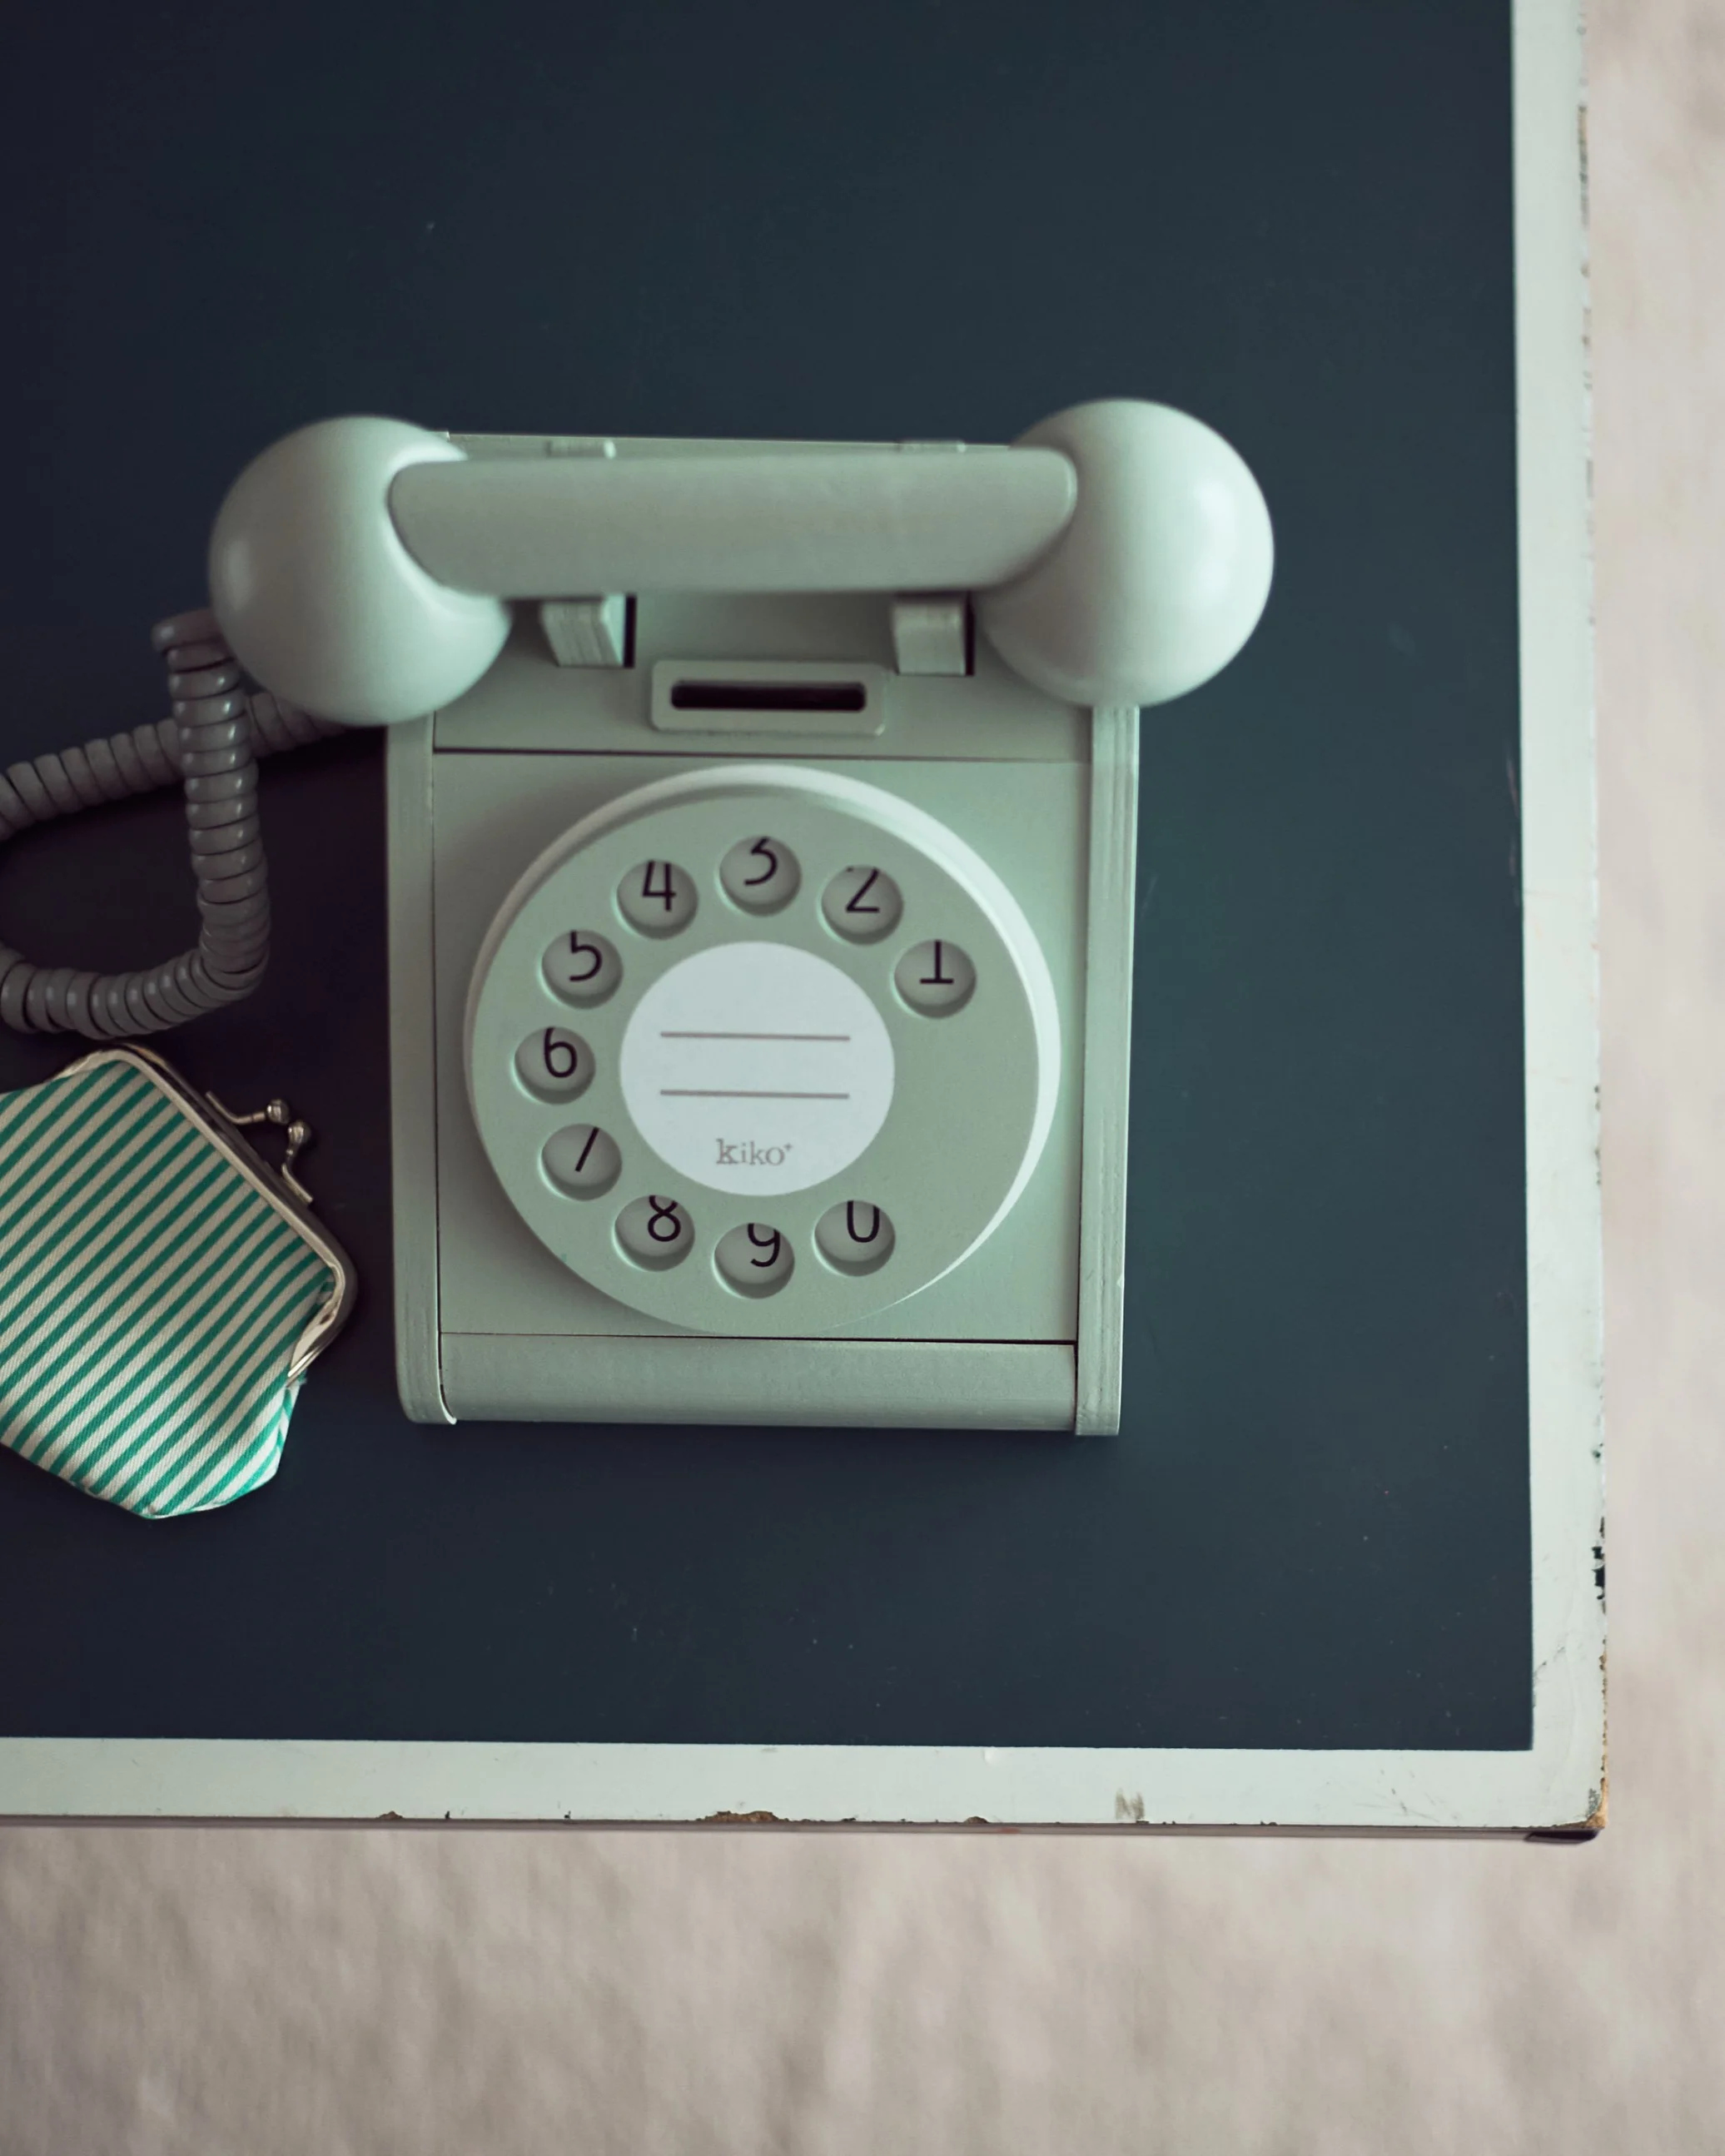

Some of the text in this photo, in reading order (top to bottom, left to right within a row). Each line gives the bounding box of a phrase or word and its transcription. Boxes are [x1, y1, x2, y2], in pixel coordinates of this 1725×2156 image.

[642, 861, 677, 912] 4
[569, 931, 603, 982] 5
[920, 941, 954, 985] 1
[544, 1027, 578, 1079] 6
[647, 1195, 682, 1243] 8
[747, 1223, 781, 1268] 9
